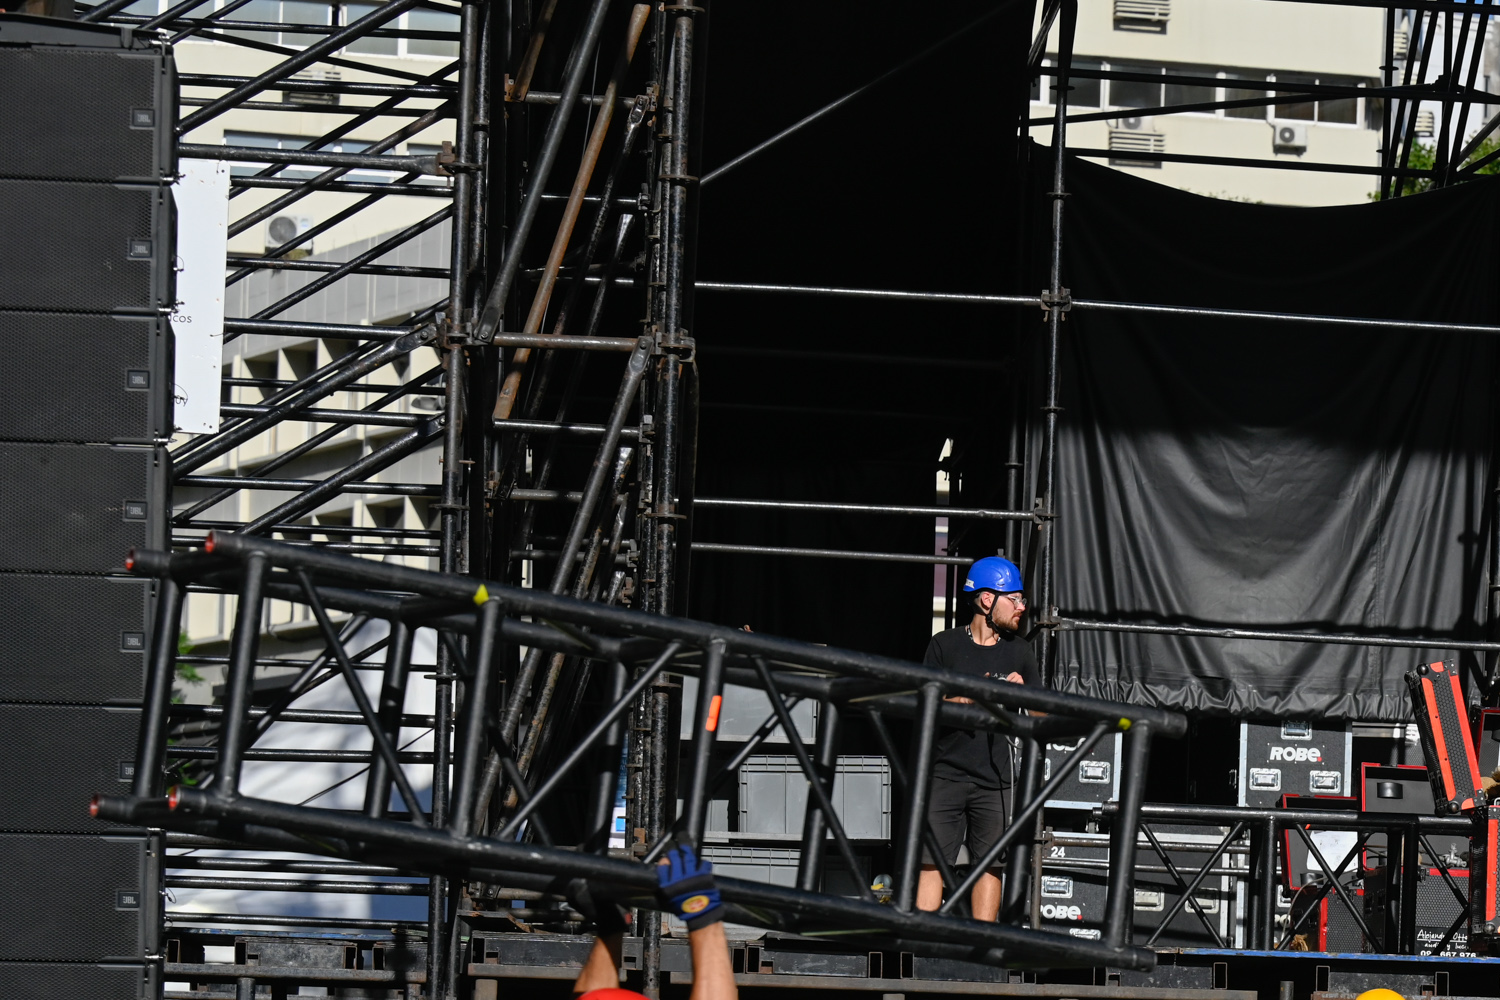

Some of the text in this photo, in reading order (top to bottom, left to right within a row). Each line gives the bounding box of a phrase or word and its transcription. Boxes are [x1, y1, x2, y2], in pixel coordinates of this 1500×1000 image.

[130, 506, 144, 515] JBL
[127, 637, 141, 646] JBL
[1051, 847, 1066, 858] 24
[122, 896, 136, 904] JBL
